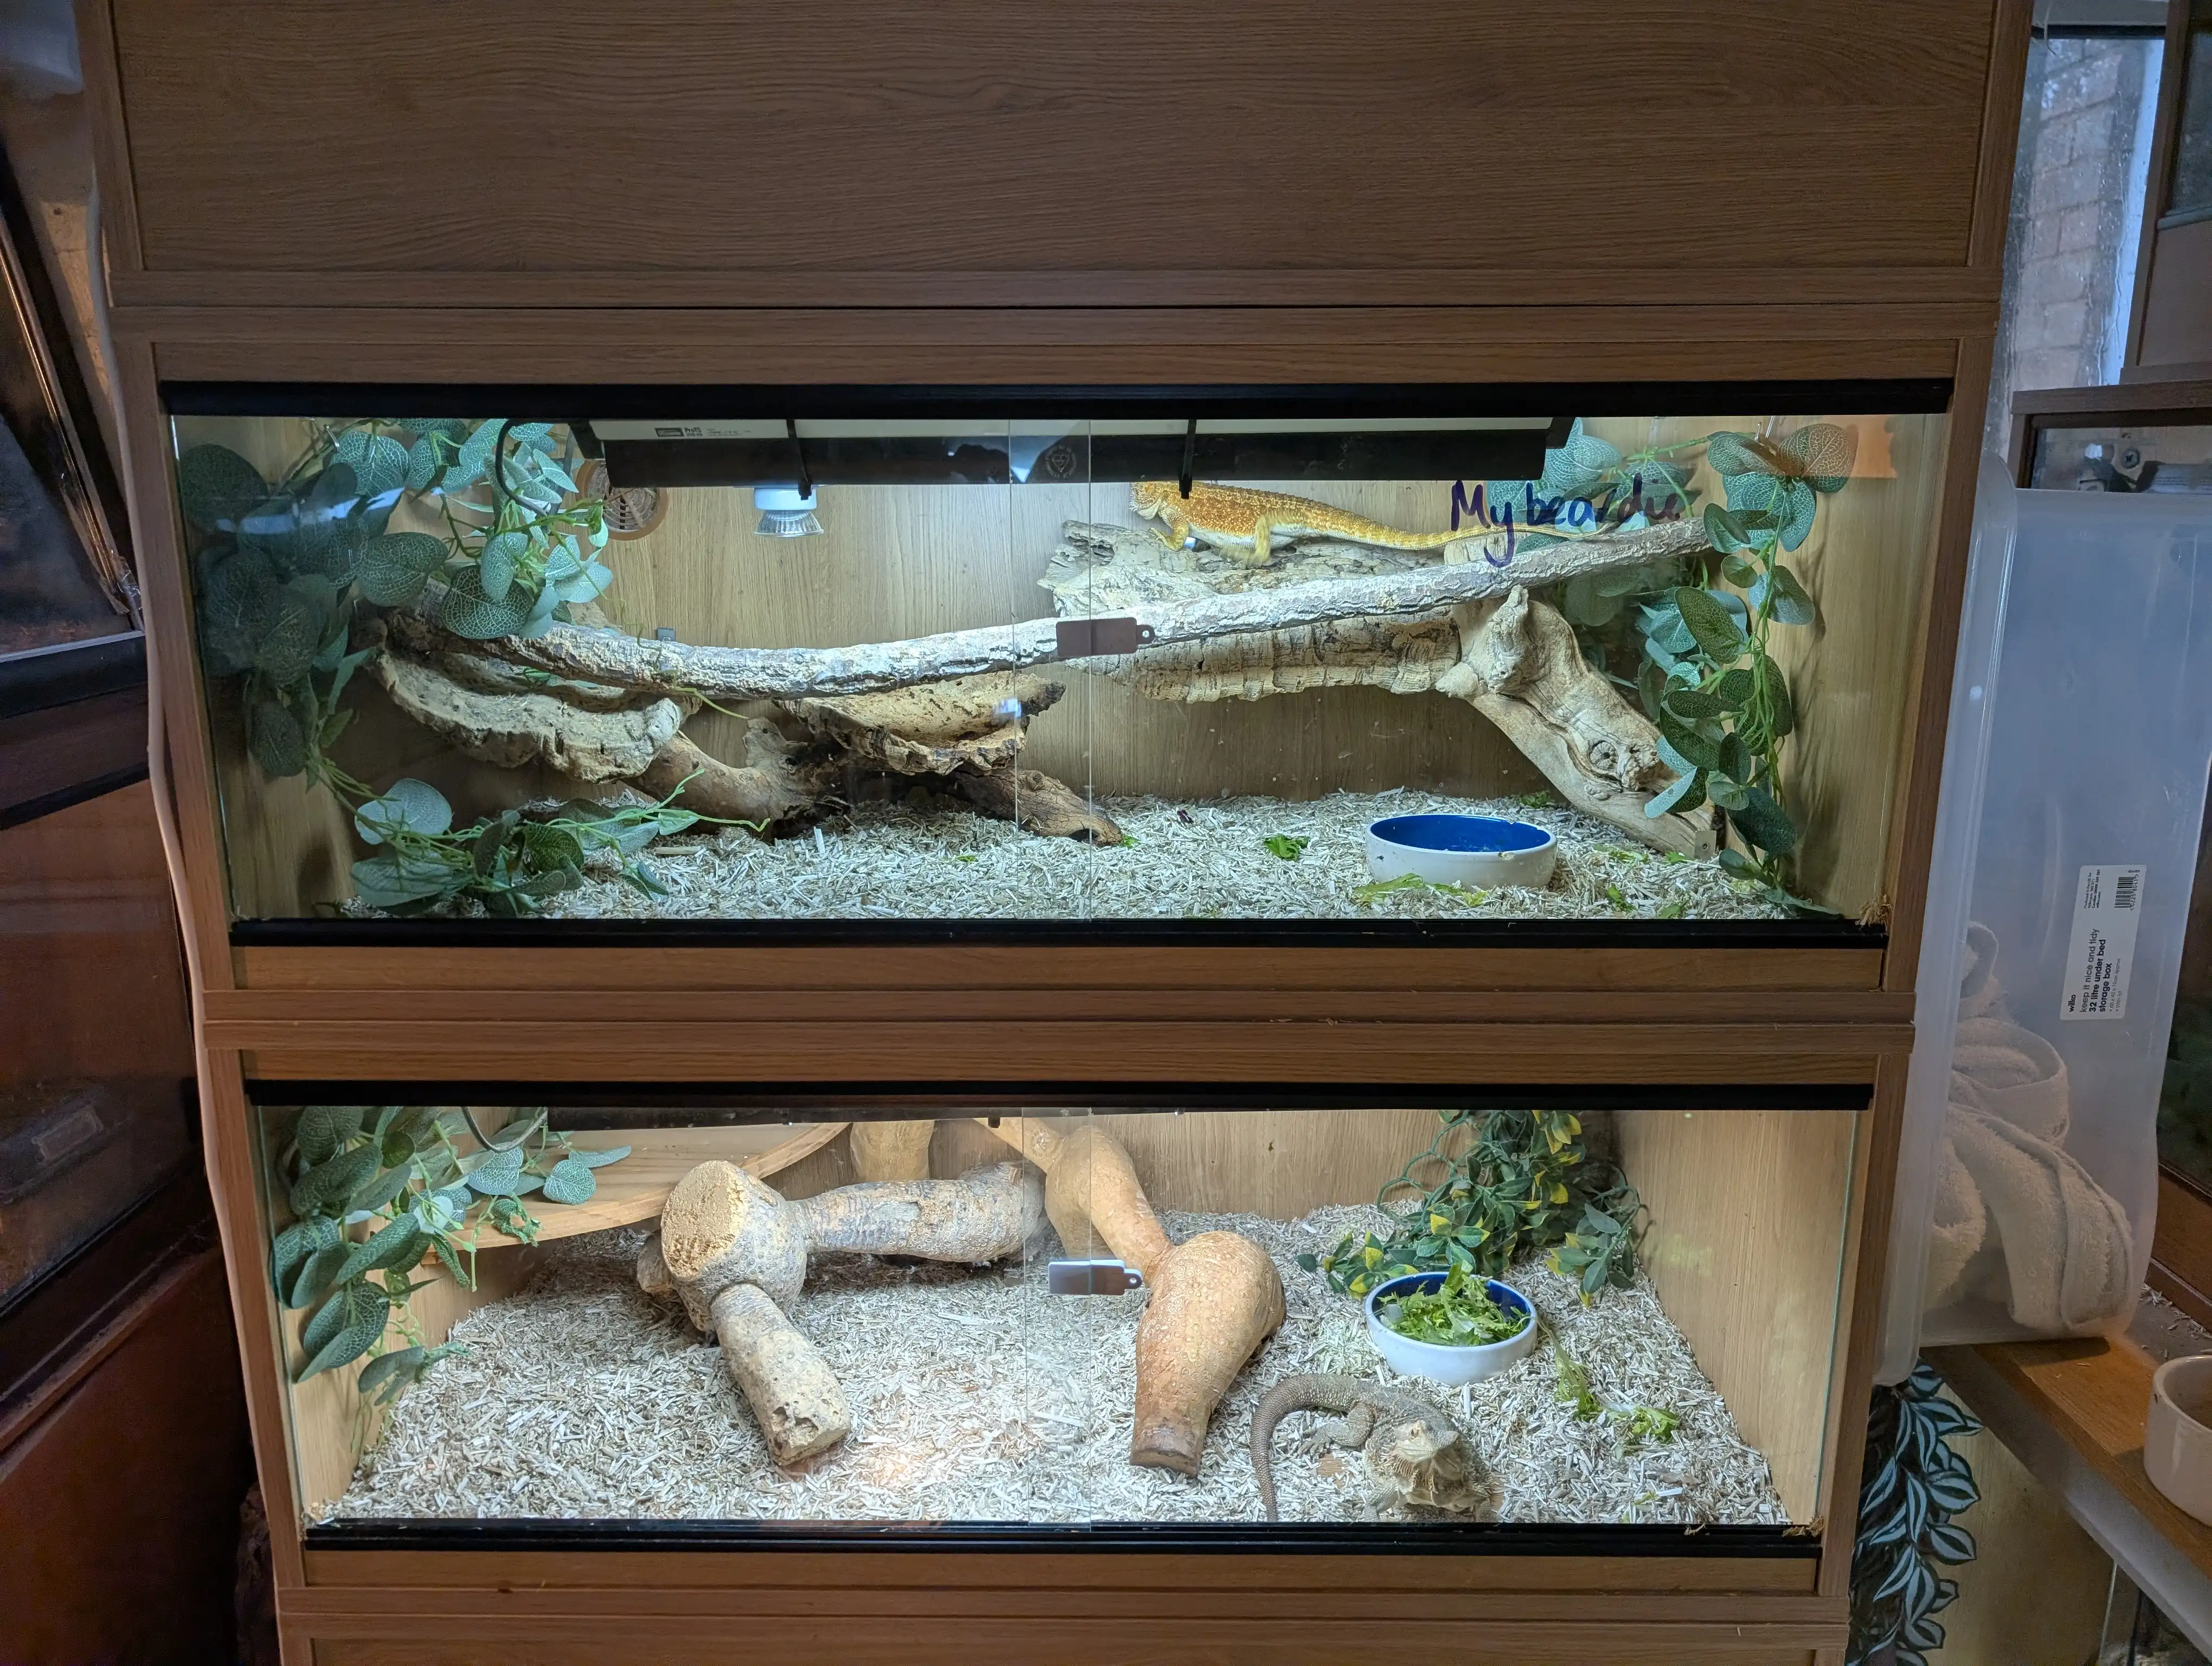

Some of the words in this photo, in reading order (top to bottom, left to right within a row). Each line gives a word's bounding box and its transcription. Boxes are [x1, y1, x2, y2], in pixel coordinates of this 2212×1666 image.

[1451, 480, 1514, 567] My
[2088, 928, 2099, 944] tidy
[2097, 939, 2106, 956] bed
[2085, 965, 2093, 982] nice
[2095, 958, 2103, 982] under
[2103, 963, 2112, 978] box
[2091, 984, 2099, 999] litre
[2099, 981, 2110, 1012] storage
[2068, 994, 2076, 1012] wilko
[2080, 992, 2089, 1012] keep
[2089, 1002, 2097, 1012] 32
